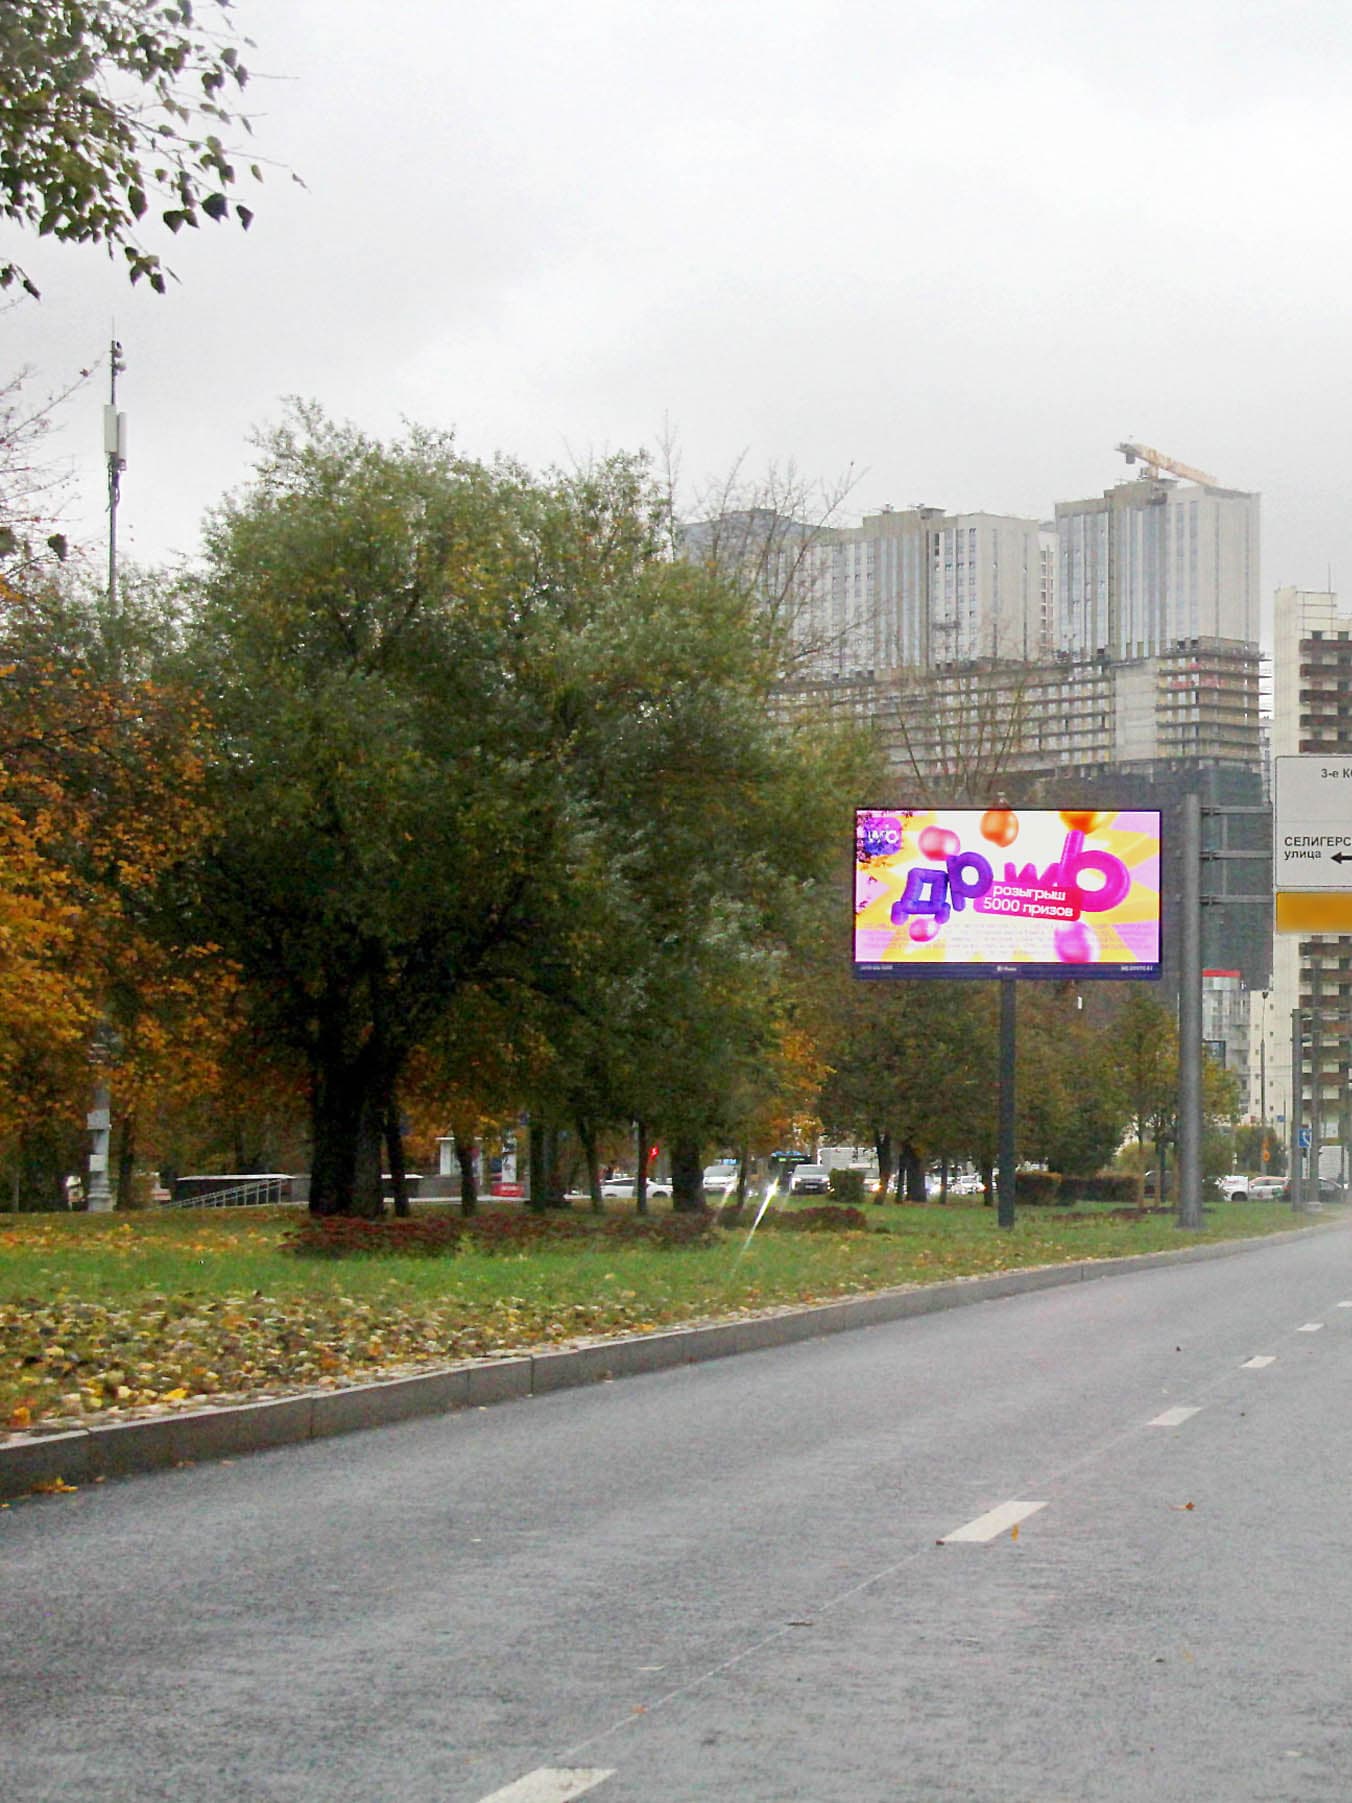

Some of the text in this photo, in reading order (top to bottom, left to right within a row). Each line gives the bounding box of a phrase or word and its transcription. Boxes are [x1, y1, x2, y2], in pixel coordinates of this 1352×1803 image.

[1321, 768, 1339, 779] 3-е
[1284, 849, 1322, 860] улица
[993, 886, 1066, 901] розыгрыш
[984, 897, 1073, 917] 5000 призов
